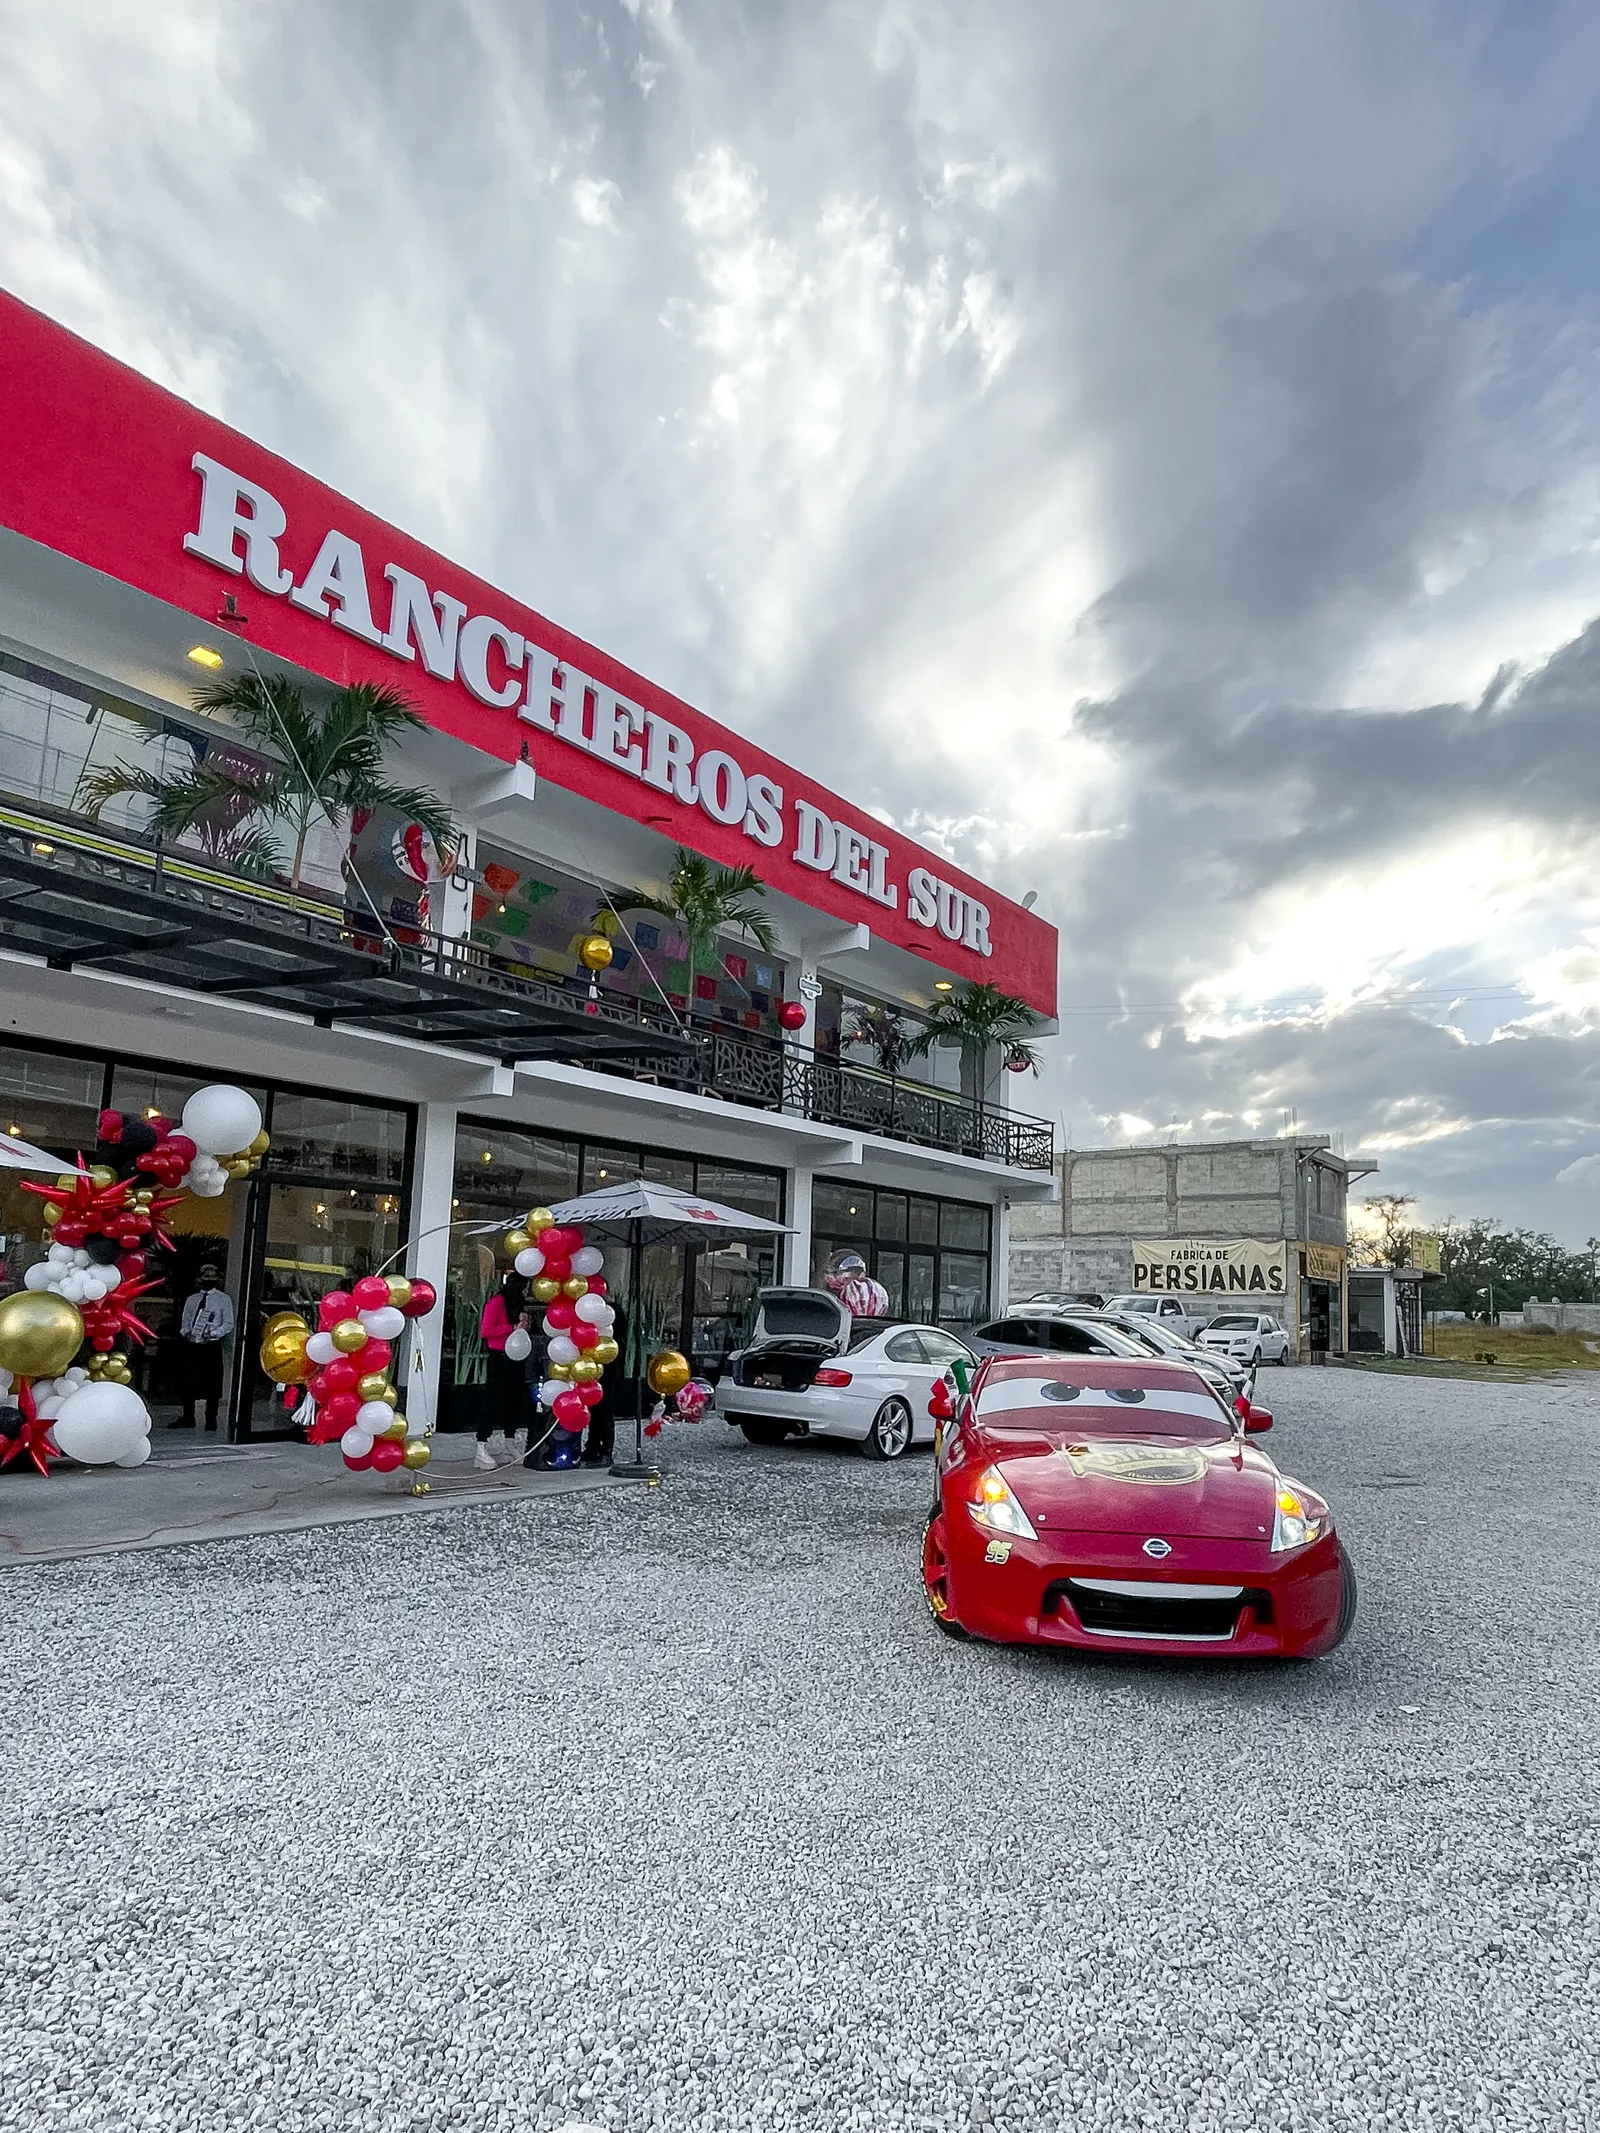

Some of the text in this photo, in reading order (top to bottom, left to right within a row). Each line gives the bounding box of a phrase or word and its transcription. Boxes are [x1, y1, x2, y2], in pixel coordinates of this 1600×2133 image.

[183, 452, 993, 957] RANCHEROS DEL SUR
[1170, 1250, 1229, 1260] FABRICA DE
[1134, 1263, 1283, 1291] PERSIANAS
[985, 1540, 1013, 1564] 95
